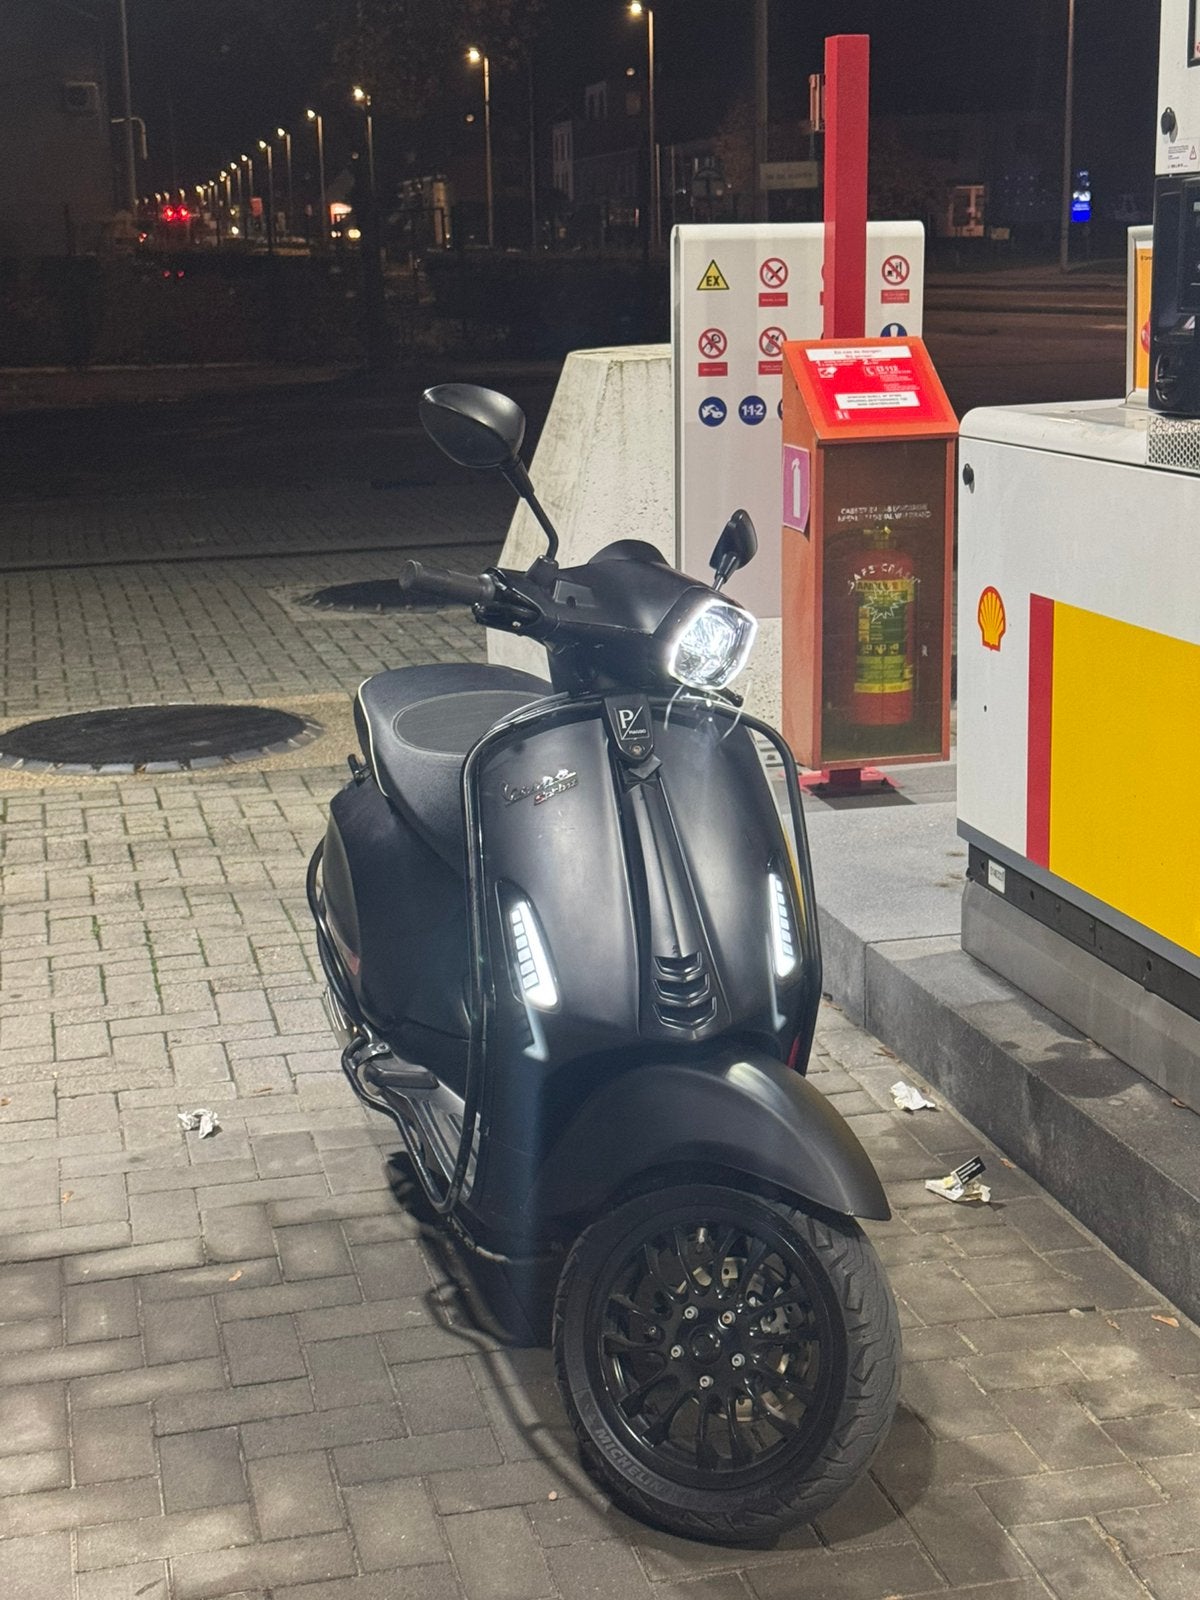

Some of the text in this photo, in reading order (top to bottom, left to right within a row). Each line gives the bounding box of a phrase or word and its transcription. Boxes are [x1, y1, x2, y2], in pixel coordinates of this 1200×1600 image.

[706, 275, 720, 287] EX
[618, 709, 634, 729] P
[595, 1427, 668, 1494] MICHELIN
